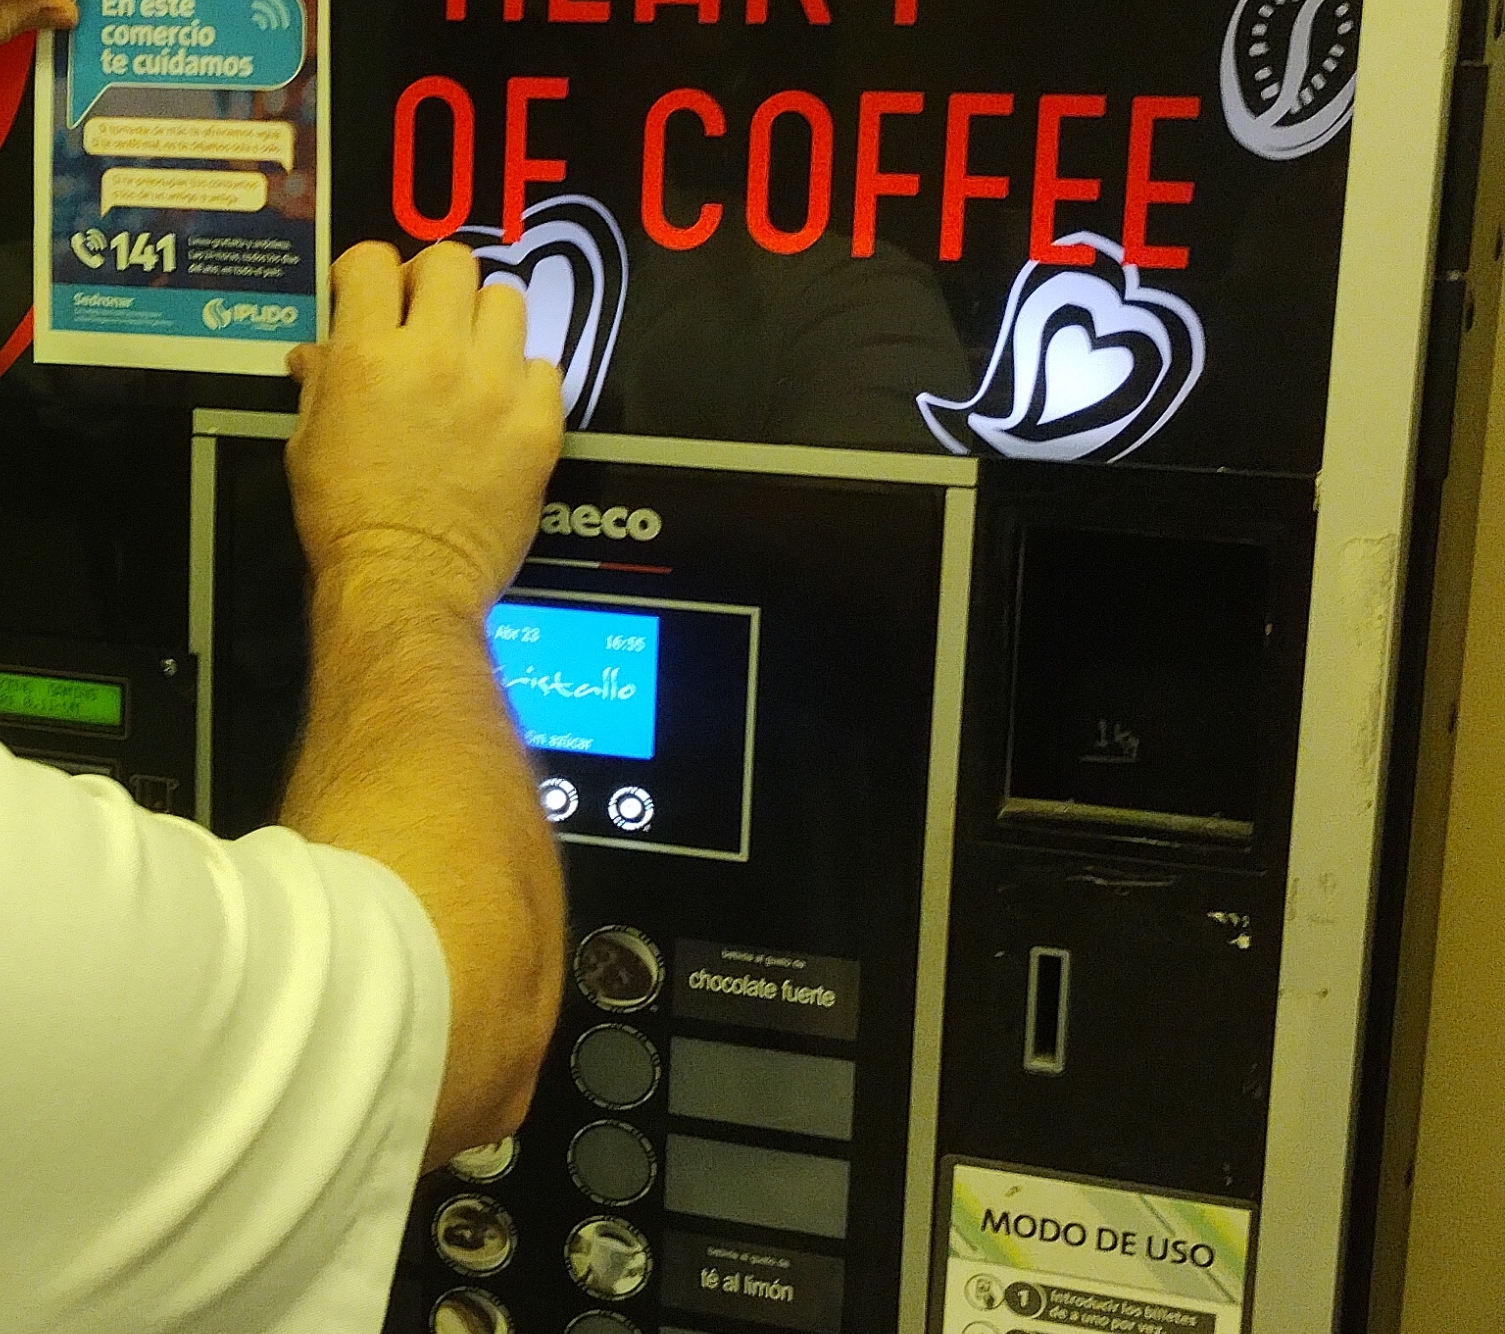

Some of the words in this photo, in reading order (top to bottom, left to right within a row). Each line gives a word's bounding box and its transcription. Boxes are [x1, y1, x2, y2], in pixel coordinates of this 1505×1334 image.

[101, 20, 216, 48] comercio
[102, 51, 127, 75] te
[393, 76, 568, 243] OF
[642, 89, 1199, 268] COFFEE
[110, 230, 177, 274] 141
[539, 501, 662, 541] aeco
[494, 665, 637, 701] ristallo
[688, 967, 778, 1000] chocolate
[781, 978, 837, 1009] fuerte
[980, 1208, 1087, 1248] MODO
[1095, 1227, 1137, 1256] DE
[1146, 1234, 1216, 1269] USO
[699, 1266, 720, 1290] té
[722, 1271, 741, 1294] al
[743, 1273, 795, 1304] limón
[1016, 1289, 1030, 1308] 1
